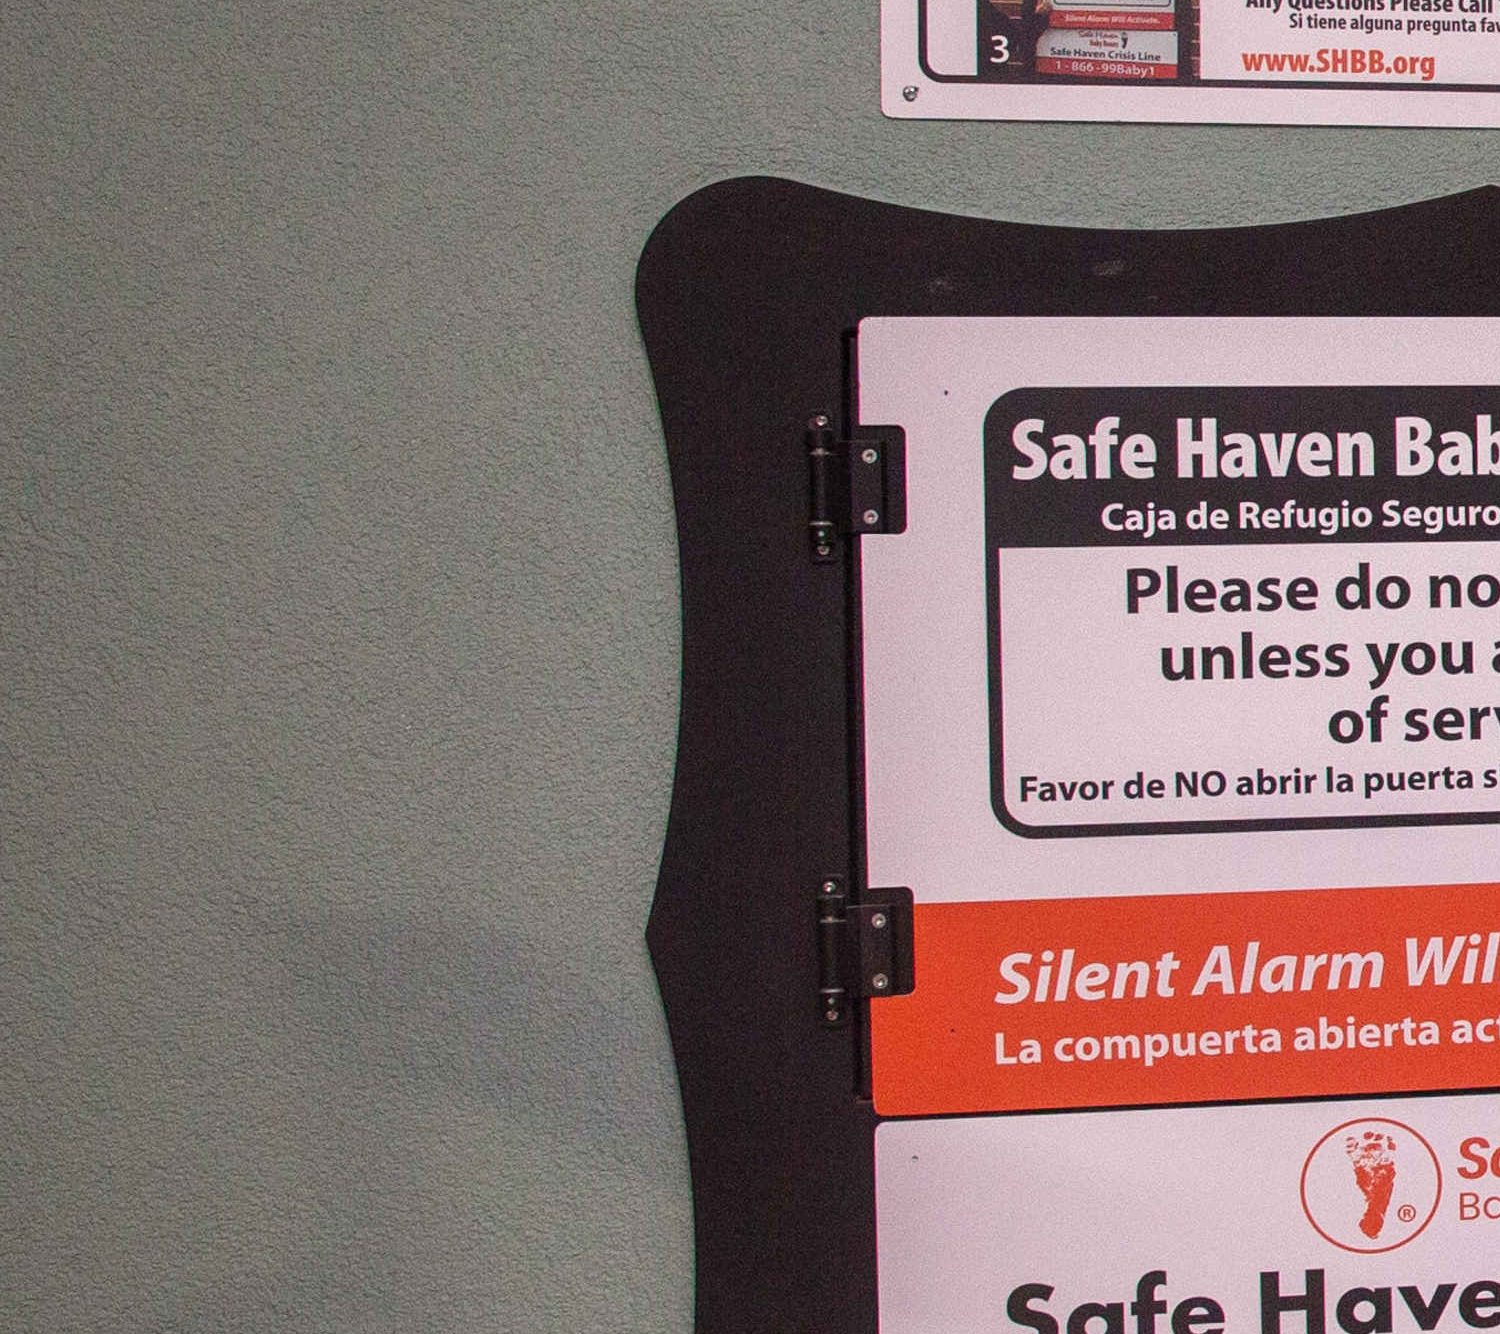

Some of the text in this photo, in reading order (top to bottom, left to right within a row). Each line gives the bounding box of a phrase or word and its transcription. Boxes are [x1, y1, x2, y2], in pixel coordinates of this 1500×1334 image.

[990, 35, 1010, 63] 3
[1050, 47, 1161, 62] Safe Haven Crisis Line
[1242, 49, 1435, 81] www.SHBB.org
[1013, 416, 1157, 480] Safe
[1177, 418, 1375, 478] Haven
[1102, 502, 1176, 538] Caja
[1186, 501, 1229, 530] de
[1240, 500, 1373, 535] Refugio
[1127, 565, 1318, 614] Please
[1336, 562, 1411, 610] do
[1161, 631, 1350, 681] unless
[1365, 641, 1474, 690] you
[1329, 694, 1391, 744] of
[1020, 776, 1115, 802] Favor
[1124, 772, 1165, 799] de
[1175, 771, 1227, 798] NO
[1236, 767, 1317, 796] abrir
[1326, 766, 1354, 793] la
[1364, 766, 1473, 799] puerta
[995, 949, 1180, 1004] Silent
[1191, 942, 1384, 996] Alarm
[996, 1033, 1041, 1065] La
[1054, 1025, 1281, 1066] compuerta
[1294, 1016, 1439, 1051] abierta
